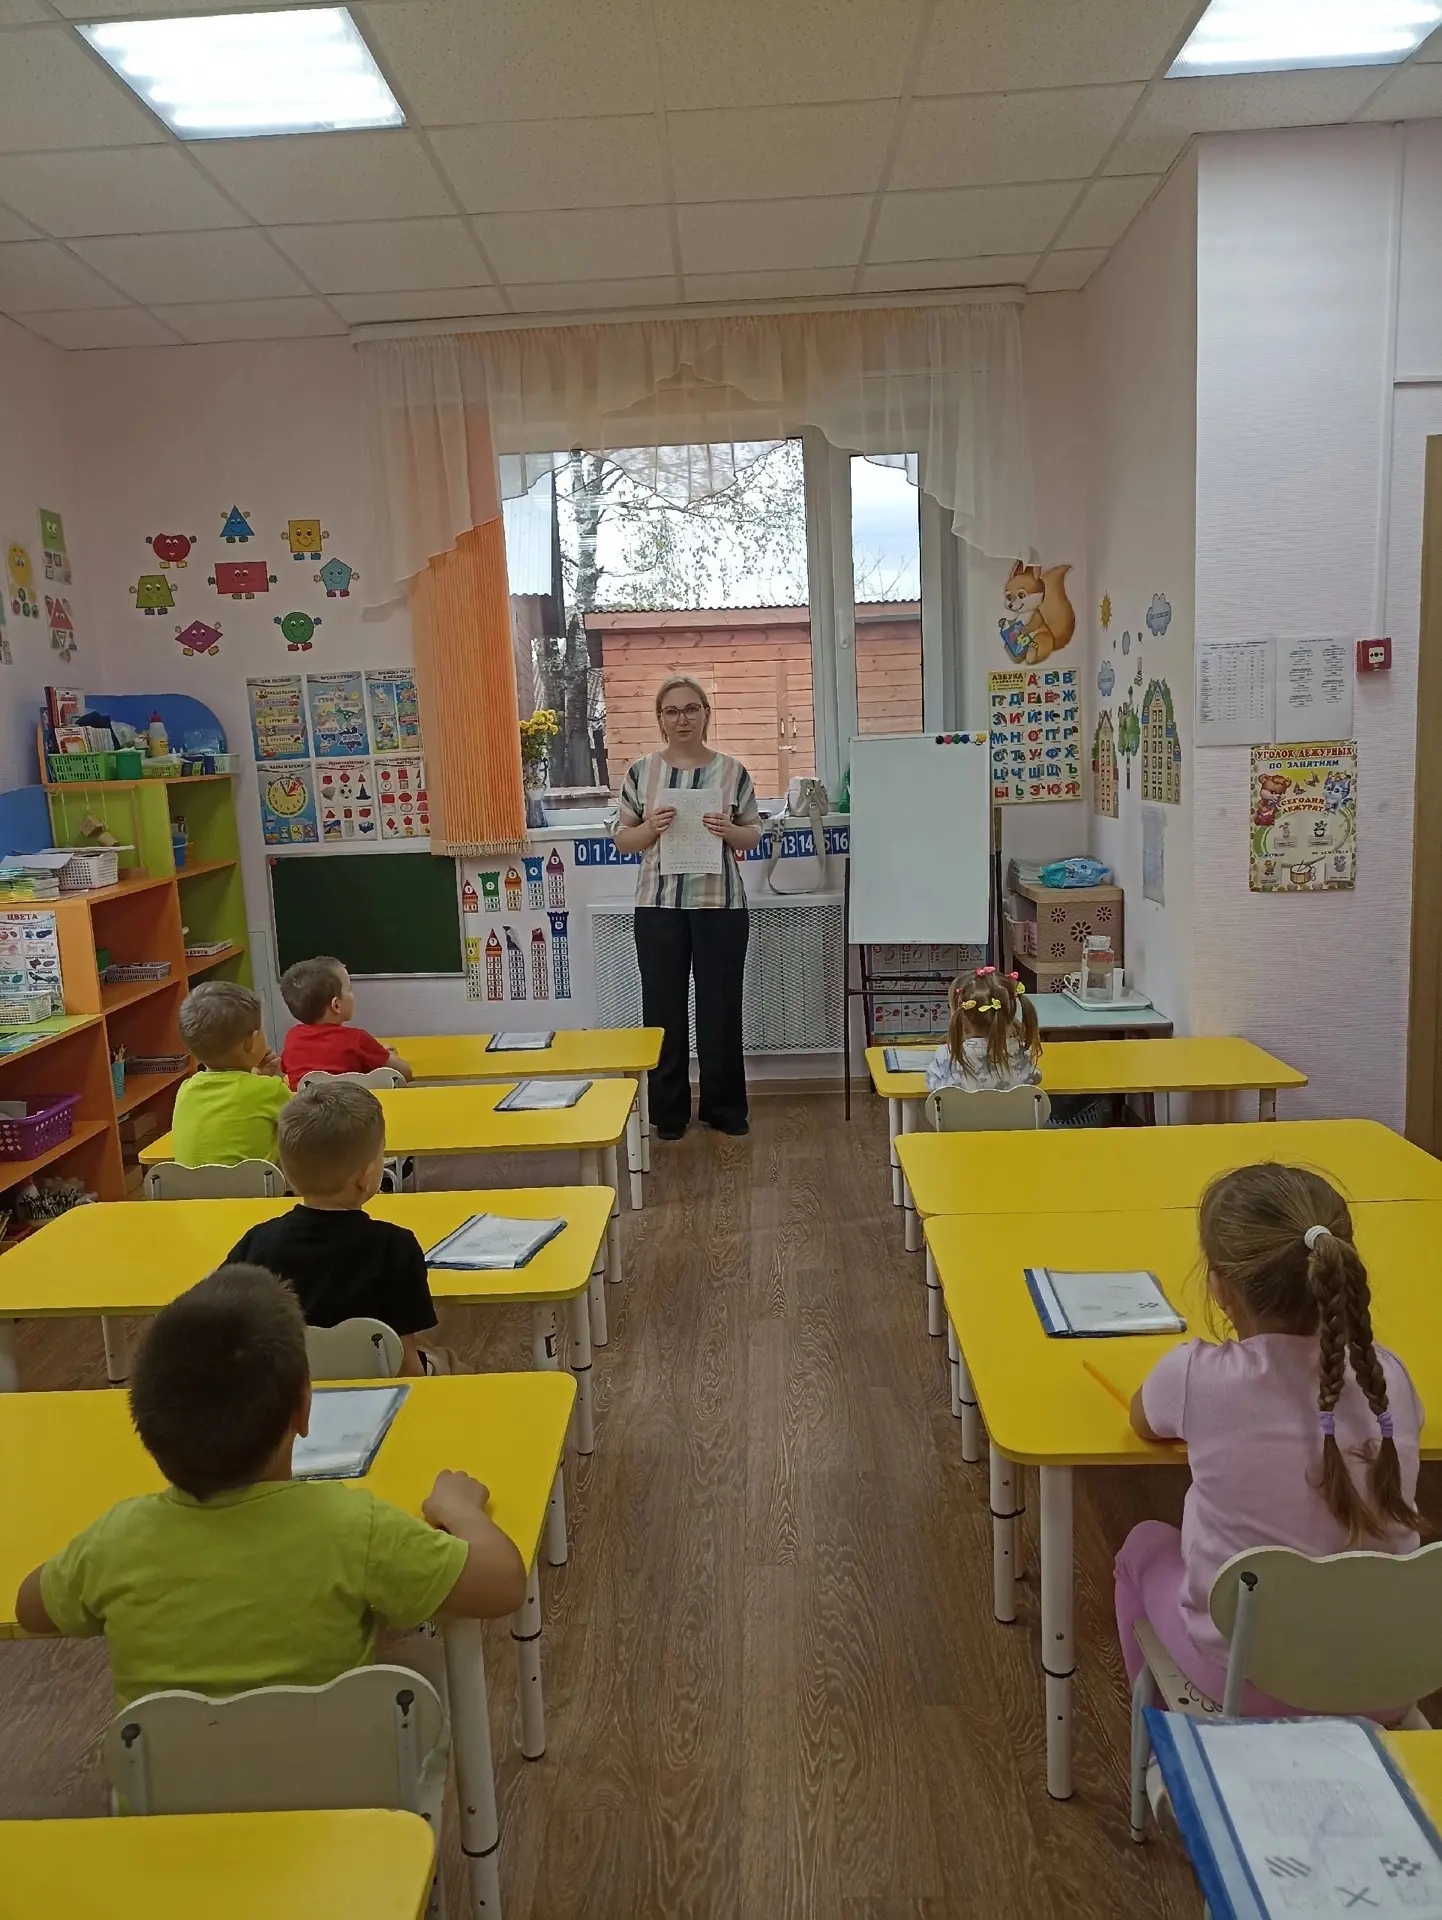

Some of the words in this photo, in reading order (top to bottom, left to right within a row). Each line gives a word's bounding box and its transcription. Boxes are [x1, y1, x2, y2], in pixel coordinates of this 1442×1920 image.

[992, 673, 1023, 681] АЗБУКА
[1027, 674, 1038, 686] А
[1044, 673, 1055, 685] Б
[1062, 672, 1073, 684] В
[1009, 693, 1021, 706] Д
[1027, 692, 1037, 704] Е
[1044, 689, 1054, 703] Ё
[1063, 689, 1075, 702] Ж
[992, 713, 1002, 726] З
[1009, 712, 1021, 724] И
[1027, 709, 1039, 723] Й
[1044, 710, 1055, 722] К
[991, 732, 1004, 744] М
[1010, 731, 1021, 743] Н
[1028, 730, 1039, 742] О
[1045, 729, 1057, 740] П
[1063, 728, 1073, 740] Р
[1010, 750, 1020, 761] Т
[1028, 749, 1038, 760] У
[1046, 748, 1059, 759] Ф
[1257, 749, 1294, 759] УГОЛОК
[1298, 747, 1352, 758] ДЕЖУРНЫХ
[1287, 760, 1339, 768] ЗАНЯТИЯМ
[994, 769, 1005, 780] Ц
[1011, 768, 1022, 779] Ч
[1029, 767, 1041, 779] Ш
[1047, 764, 1059, 777] Щ
[1066, 763, 1078, 774] Ъ
[994, 787, 1009, 798] Ы
[1015, 785, 1024, 796] Ь
[1029, 784, 1041, 796] Э
[1047, 783, 1061, 795] Ю
[1065, 783, 1076, 794] Я
[1281, 797, 1324, 805] СЕГОДНЯ
[1282, 804, 1324, 814] ДЕЖУРЯТ
[782, 835, 795, 854] 13
[799, 834, 814, 853] 14
[833, 832, 849, 851] 16
[578, 844, 587, 862] 0
[593, 844, 600, 862] 1
[608, 843, 617, 861] 2
